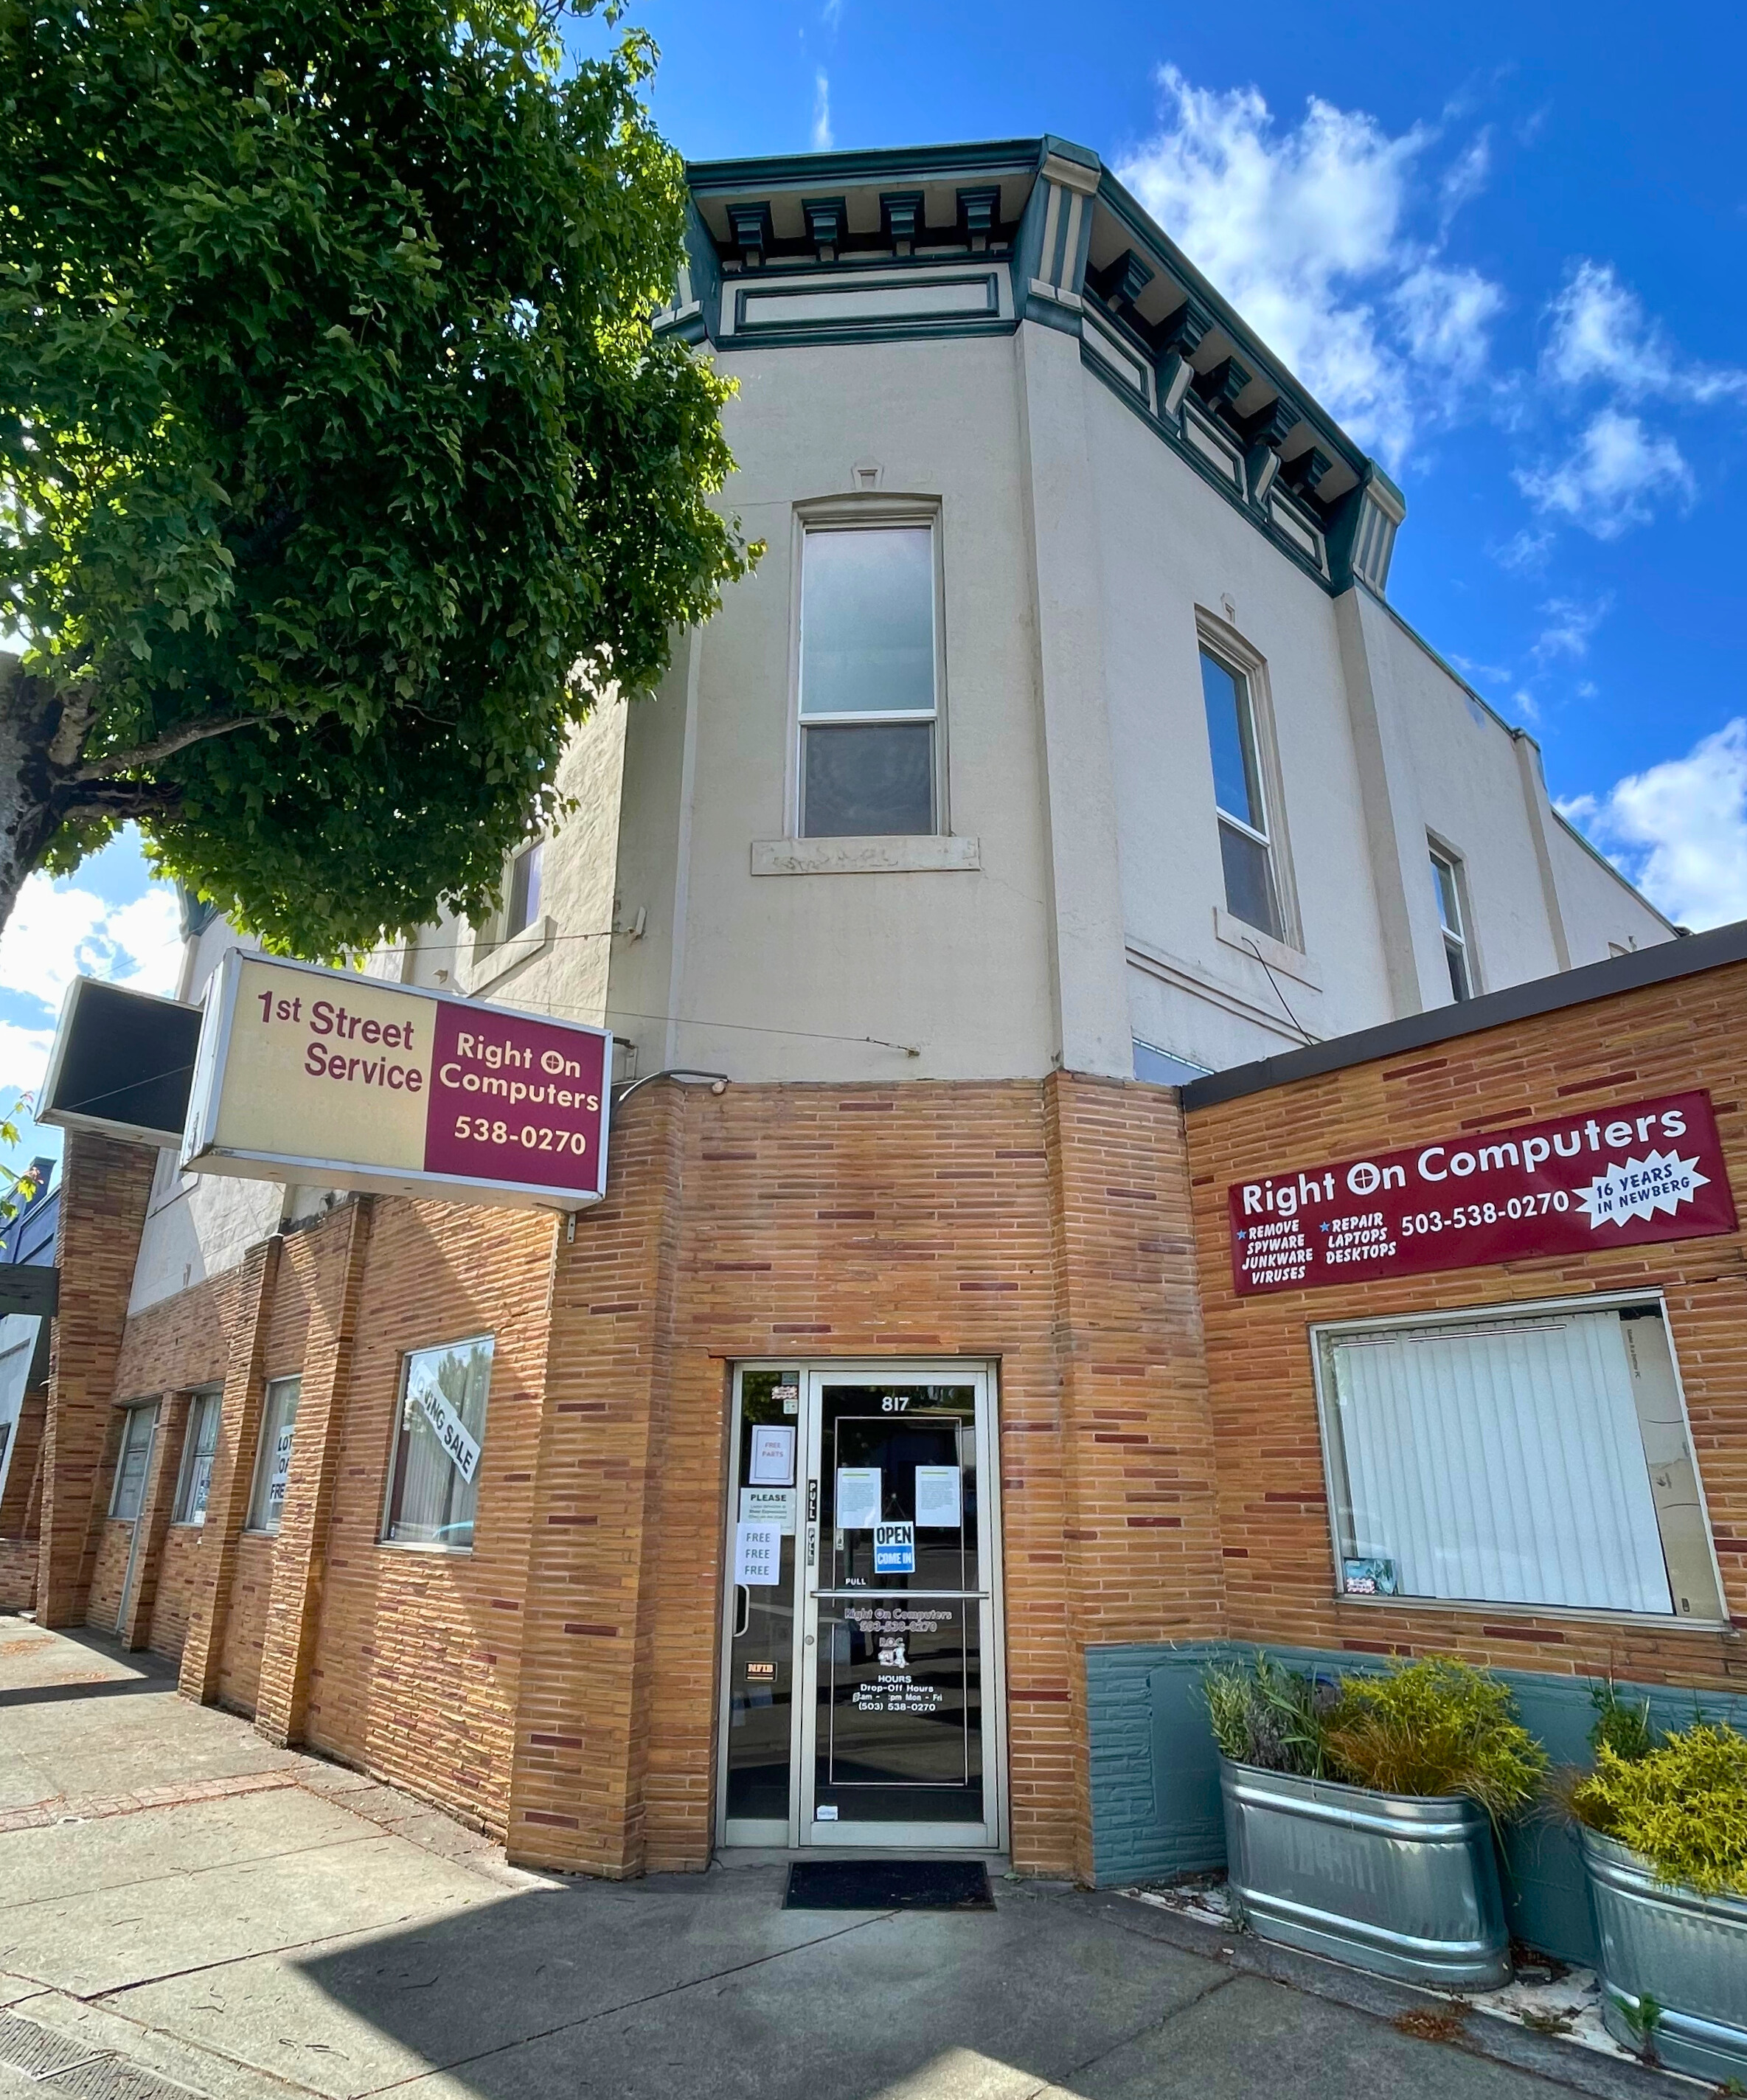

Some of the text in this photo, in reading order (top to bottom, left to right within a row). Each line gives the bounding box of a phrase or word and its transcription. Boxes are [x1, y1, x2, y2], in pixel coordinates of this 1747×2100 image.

[257, 990, 302, 1023] 1st
[310, 1001, 414, 1050] Street
[456, 1032, 581, 1078] Right On
[305, 1042, 423, 1092] Service
[439, 1062, 600, 1112] Computers
[454, 1115, 586, 1155] 538-0270
[1243, 1110, 1687, 1216] Right On Computers
[1597, 1163, 1673, 1199] 16 YEARS
[1597, 1177, 1690, 1214] IN NEWBERG
[1332, 1212, 1384, 1233] REPAIR
[1401, 1190, 1569, 1236] 503-538-0270
[1248, 1219, 1300, 1240] REMOVE
[1328, 1227, 1388, 1248] LAPTOPS
[1246, 1234, 1305, 1255] SPYWARE
[1326, 1241, 1397, 1264] DESKTOPS
[1241, 1248, 1313, 1270] JUNKWARE
[1251, 1266, 1306, 1285] VIRUSES
[882, 1396, 909, 1412] 817
[444, 1424, 473, 1474] SALE
[750, 1494, 787, 1502] PLEASE
[746, 1533, 771, 1543] FREE
[877, 1525, 911, 1545] OPEN
[745, 1548, 771, 1559] FREE
[878, 1552, 911, 1564] COME IN
[744, 1565, 770, 1576] FREE
[845, 1577, 866, 1585] PULL
[844, 1608, 953, 1621] Right On Computers
[859, 1621, 938, 1632] 503-538-0270
[748, 1663, 774, 1673] NFIB
[860, 1684, 934, 1693] Drop-Off Hours
[878, 1674, 912, 1683] HOURS
[858, 1702, 936, 1711] (503) 538-0270
[932, 1694, 942, 1702] Fri
